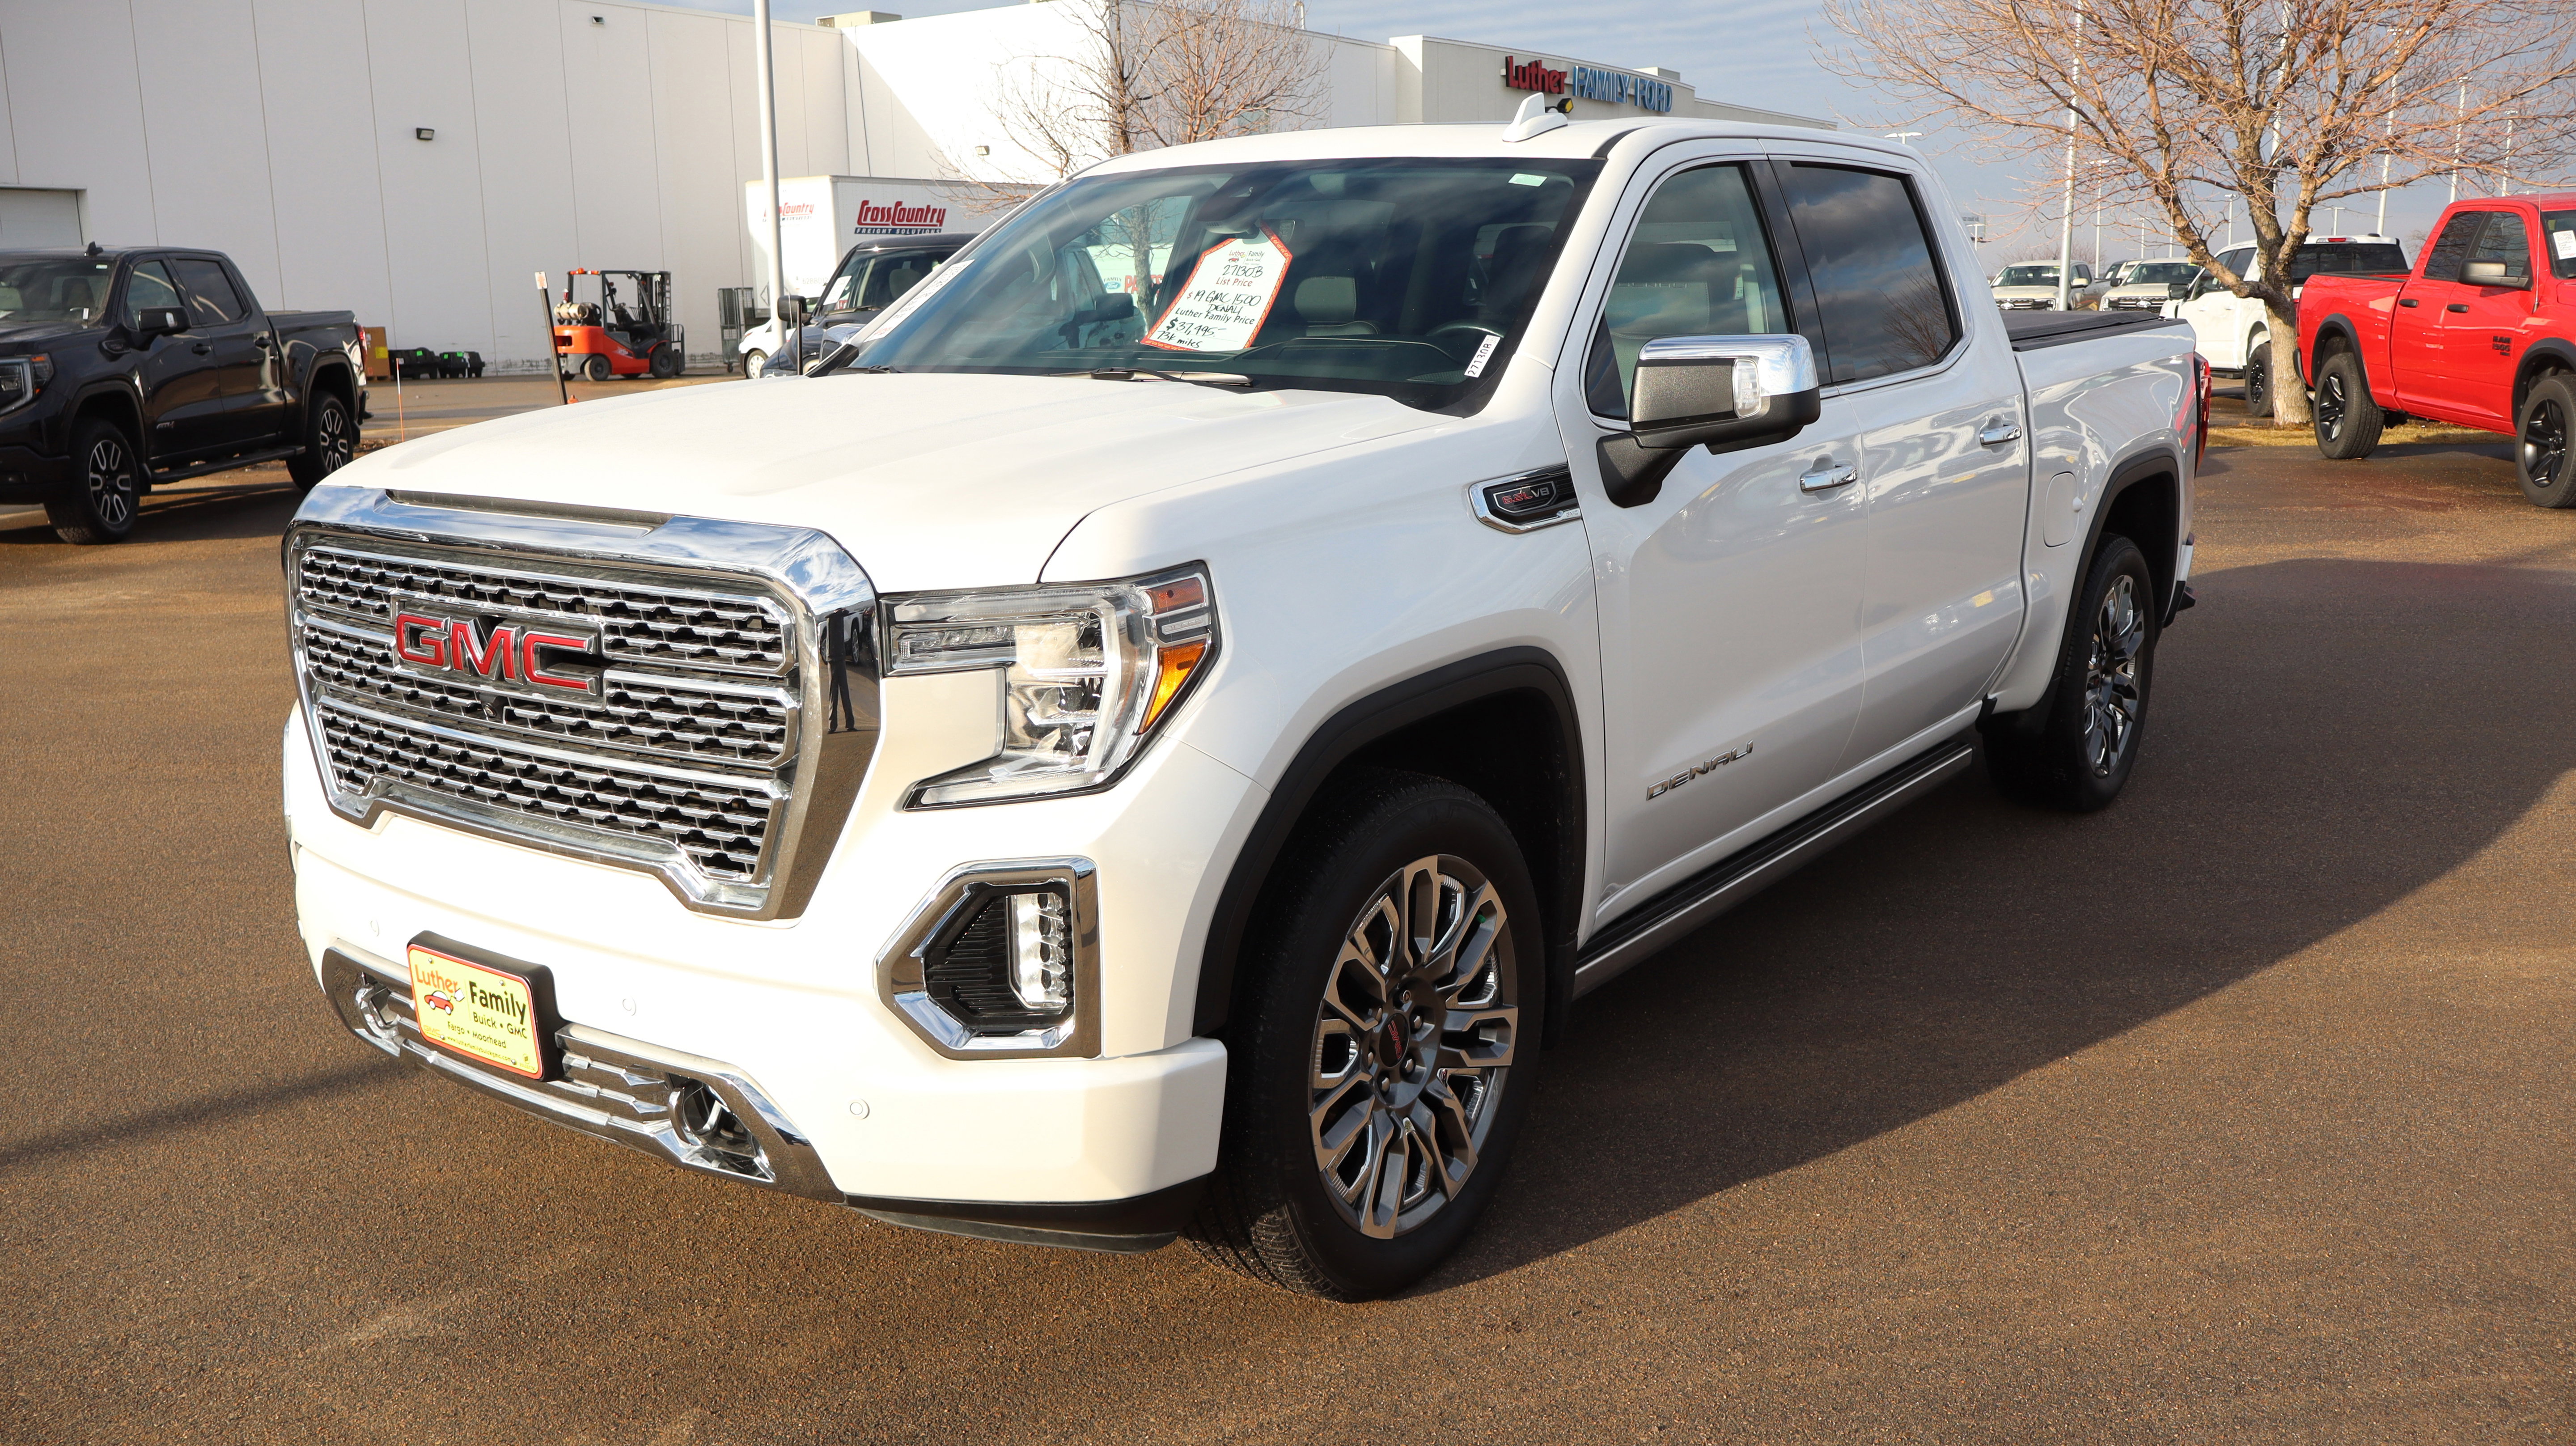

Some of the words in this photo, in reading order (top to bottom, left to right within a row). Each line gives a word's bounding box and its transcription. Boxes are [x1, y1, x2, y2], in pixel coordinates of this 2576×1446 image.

[1506, 56, 1567, 94] Luther
[1572, 66, 1631, 103] FAMILY
[1634, 78, 1674, 113] FORD
[1216, 277, 1231, 285] List
[1232, 278, 1253, 287] Price
[1222, 264, 1263, 278] 27130B
[1205, 290, 1231, 303] GMC
[1232, 293, 1261, 306] 1500
[1175, 307, 1203, 318] Luther
[1204, 312, 1231, 323] Family
[1233, 315, 1255, 325] Price
[1177, 338, 1203, 348] miles
[1467, 343, 1491, 375] 27130B
[1502, 492, 1533, 504] 6.2L
[1164, 619, 1203, 632] SIERRA
[395, 612, 601, 696] GMC
[1646, 739, 1754, 801] DENALI
[415, 964, 458, 993] Luther
[469, 981, 526, 1025] Family
[448, 1021, 465, 1035] Fargo
[473, 1031, 506, 1048] Moorhead
[473, 1012, 497, 1029] Buick
[507, 1023, 527, 1039] GMC
[1388, 1020, 1402, 1060] GMC
